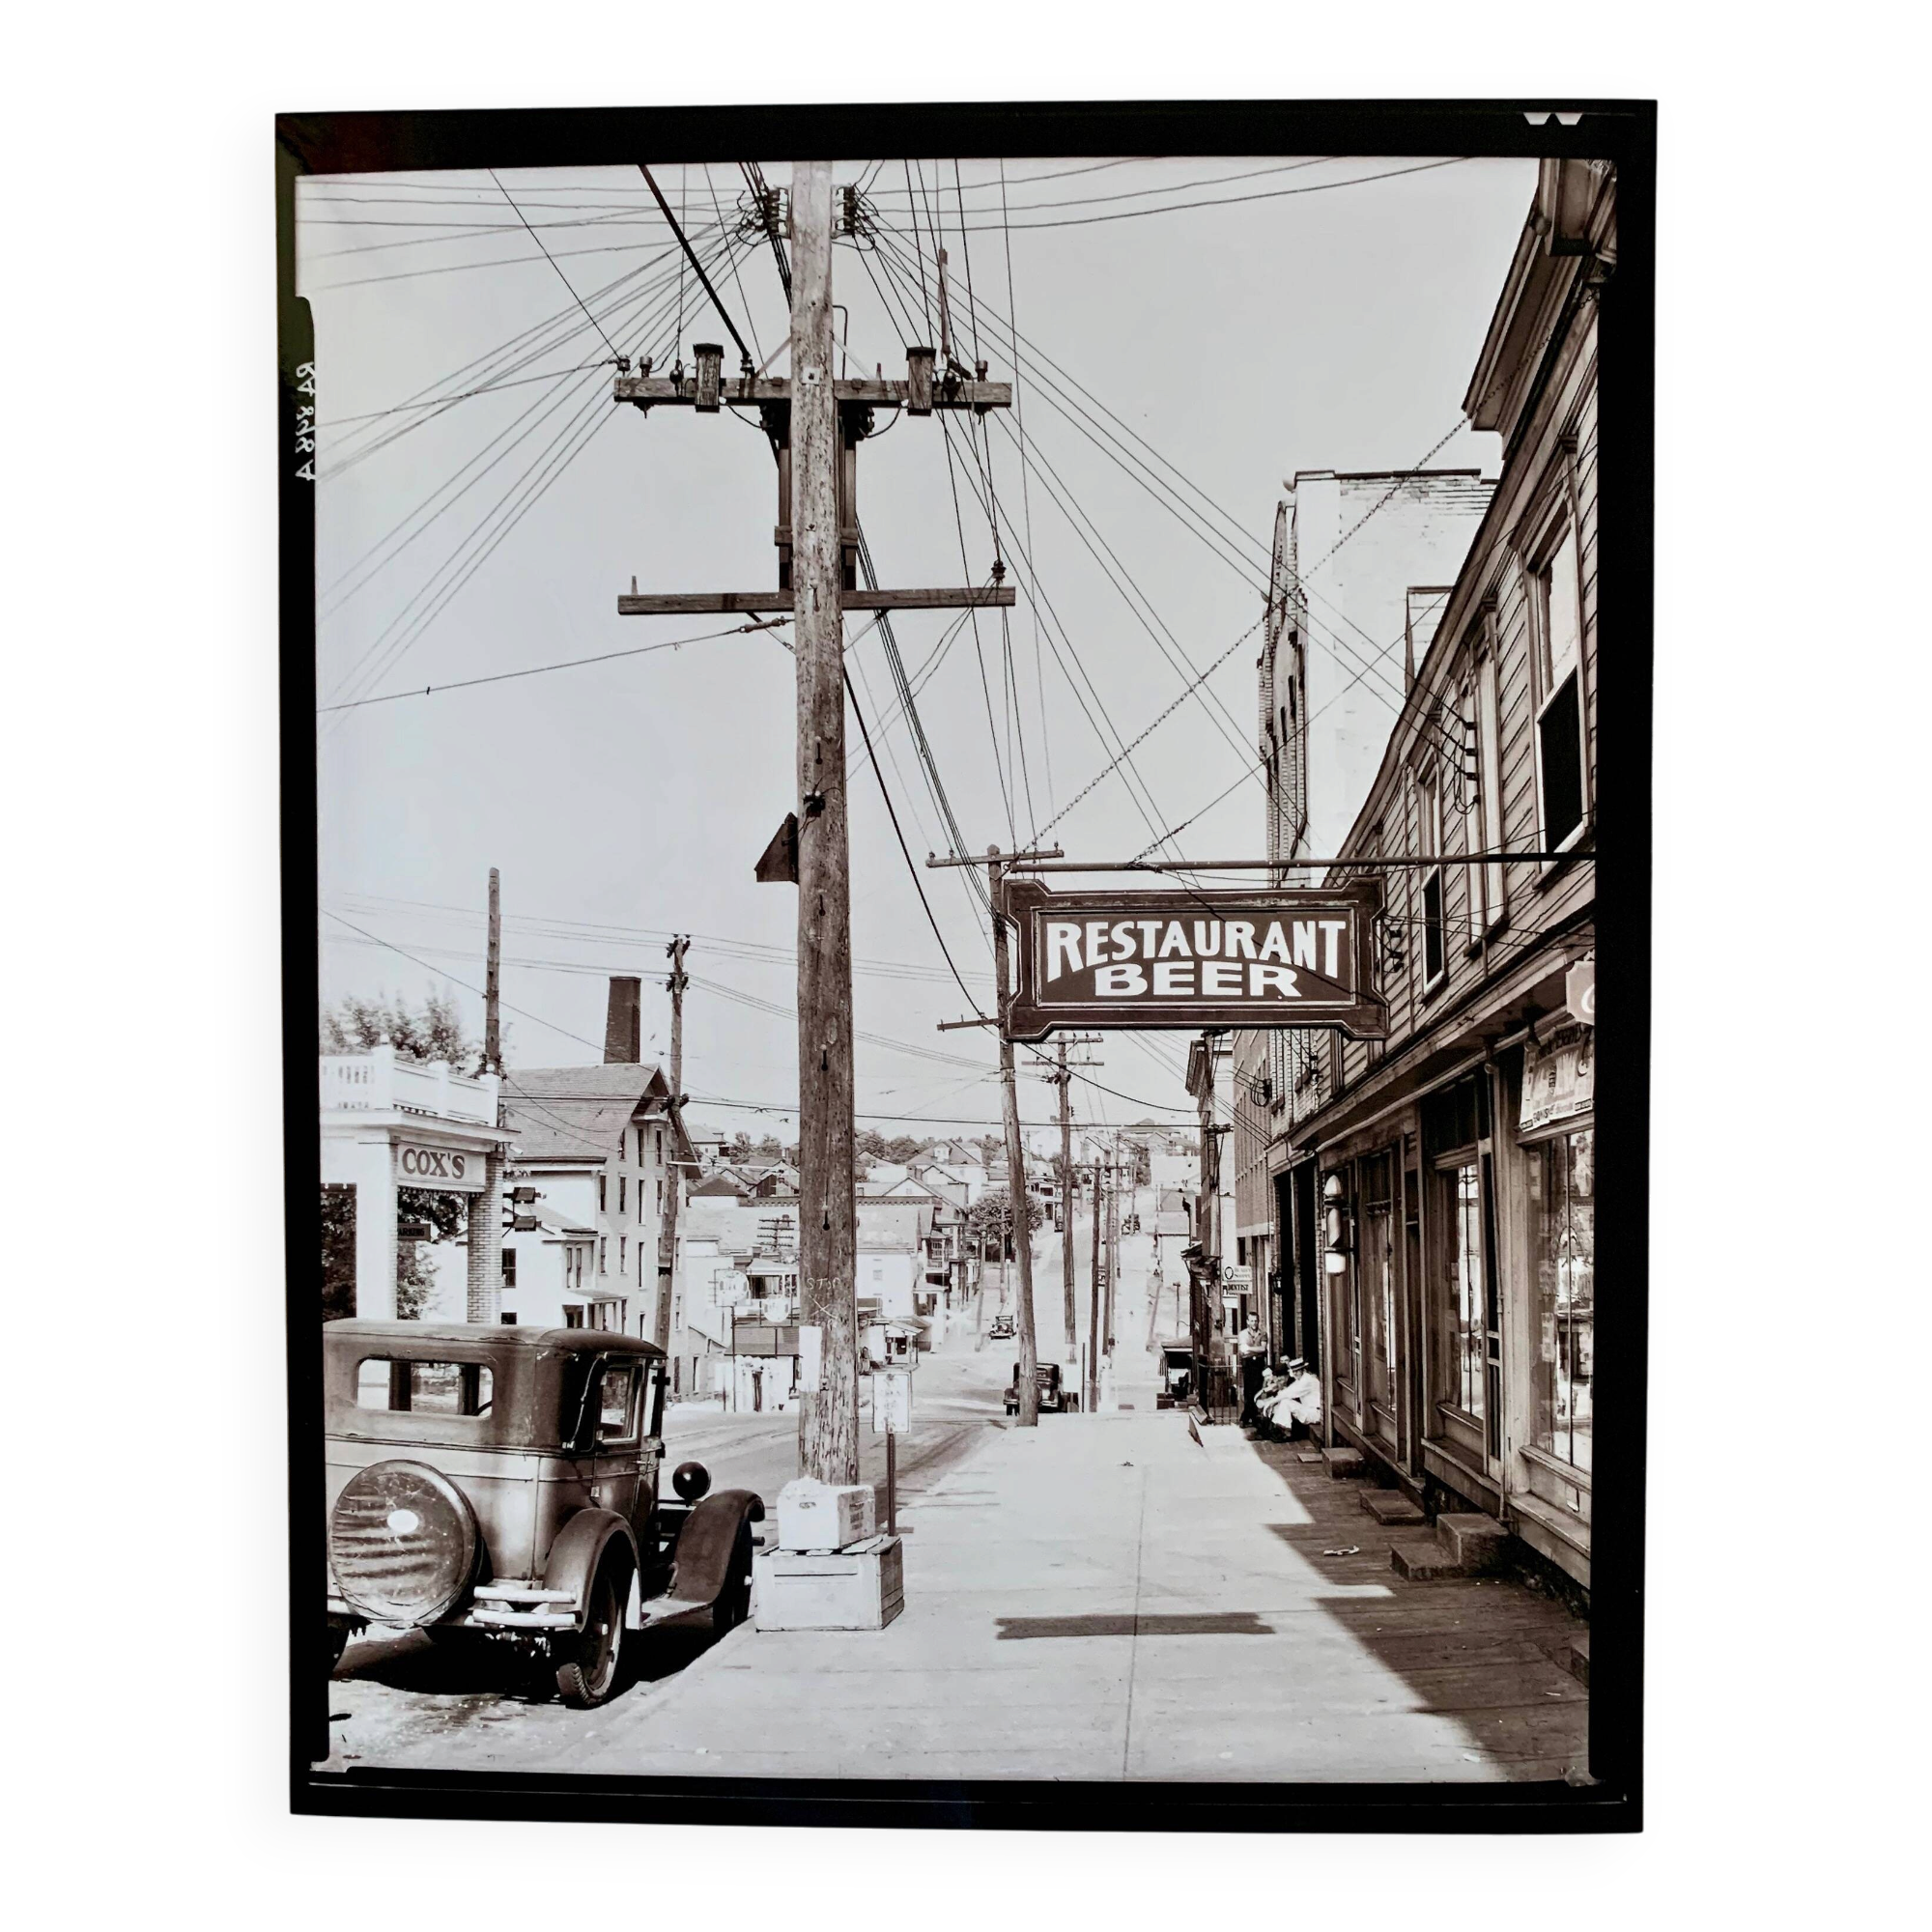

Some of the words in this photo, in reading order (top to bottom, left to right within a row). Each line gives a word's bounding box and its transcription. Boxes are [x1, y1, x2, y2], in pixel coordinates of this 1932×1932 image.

[1046, 920, 1347, 983] RESTAURANT
[1094, 960, 1303, 997] BEER
[402, 1148, 466, 1179] COX'S
